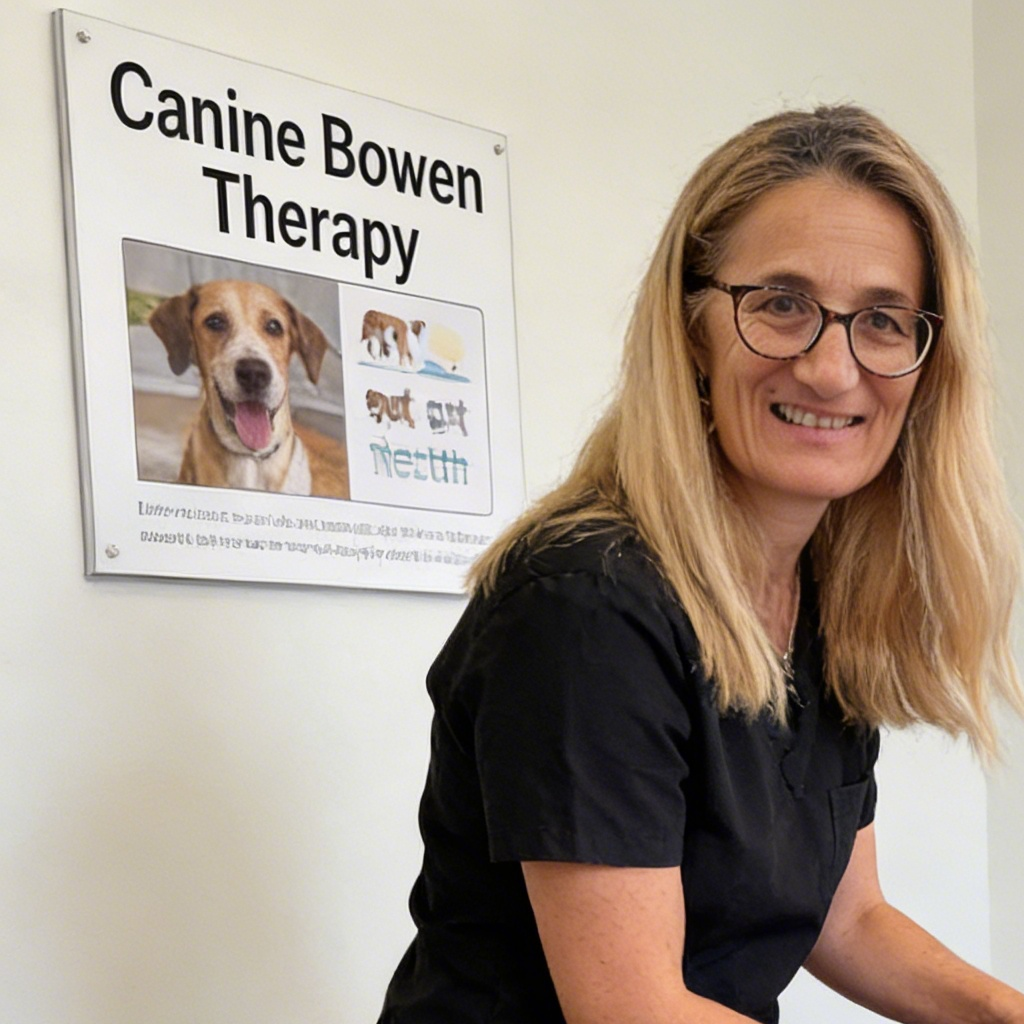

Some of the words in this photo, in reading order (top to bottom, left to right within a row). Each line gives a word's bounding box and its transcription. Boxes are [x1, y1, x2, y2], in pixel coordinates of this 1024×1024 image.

[110, 61, 306, 168] Canine
[321, 113, 484, 214] Bowen
[201, 166, 420, 285] Therapy
